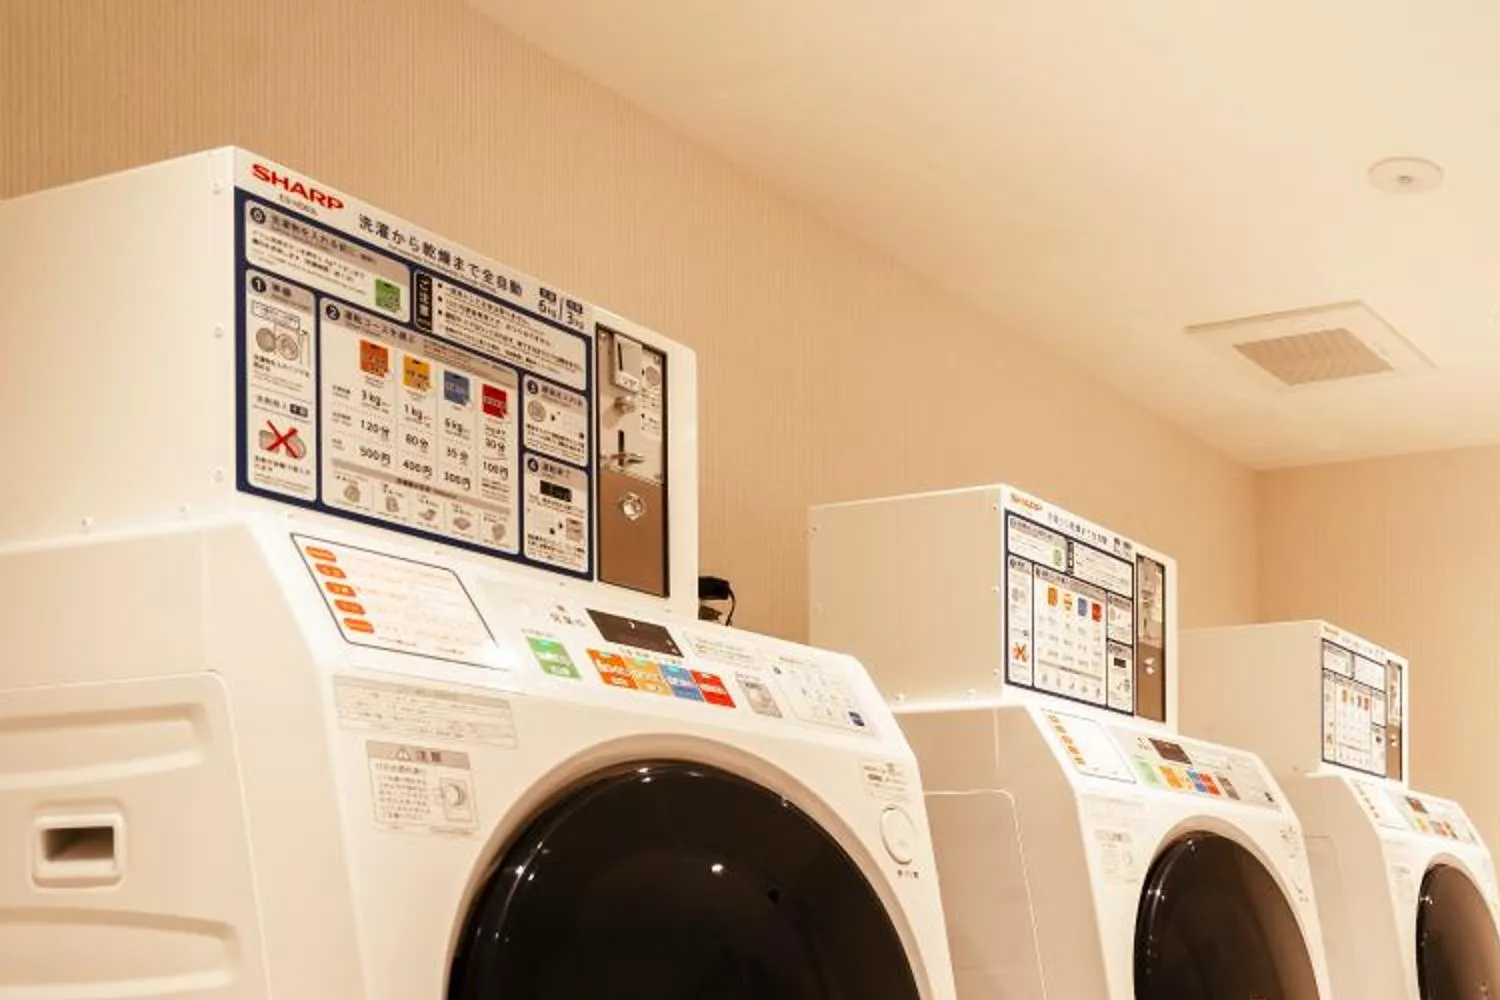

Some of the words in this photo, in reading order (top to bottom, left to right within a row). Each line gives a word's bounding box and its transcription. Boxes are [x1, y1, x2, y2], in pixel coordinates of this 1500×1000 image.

[252, 163, 345, 210] SHARP
[358, 212, 523, 297] 洗濯から乾燥まで全自動
